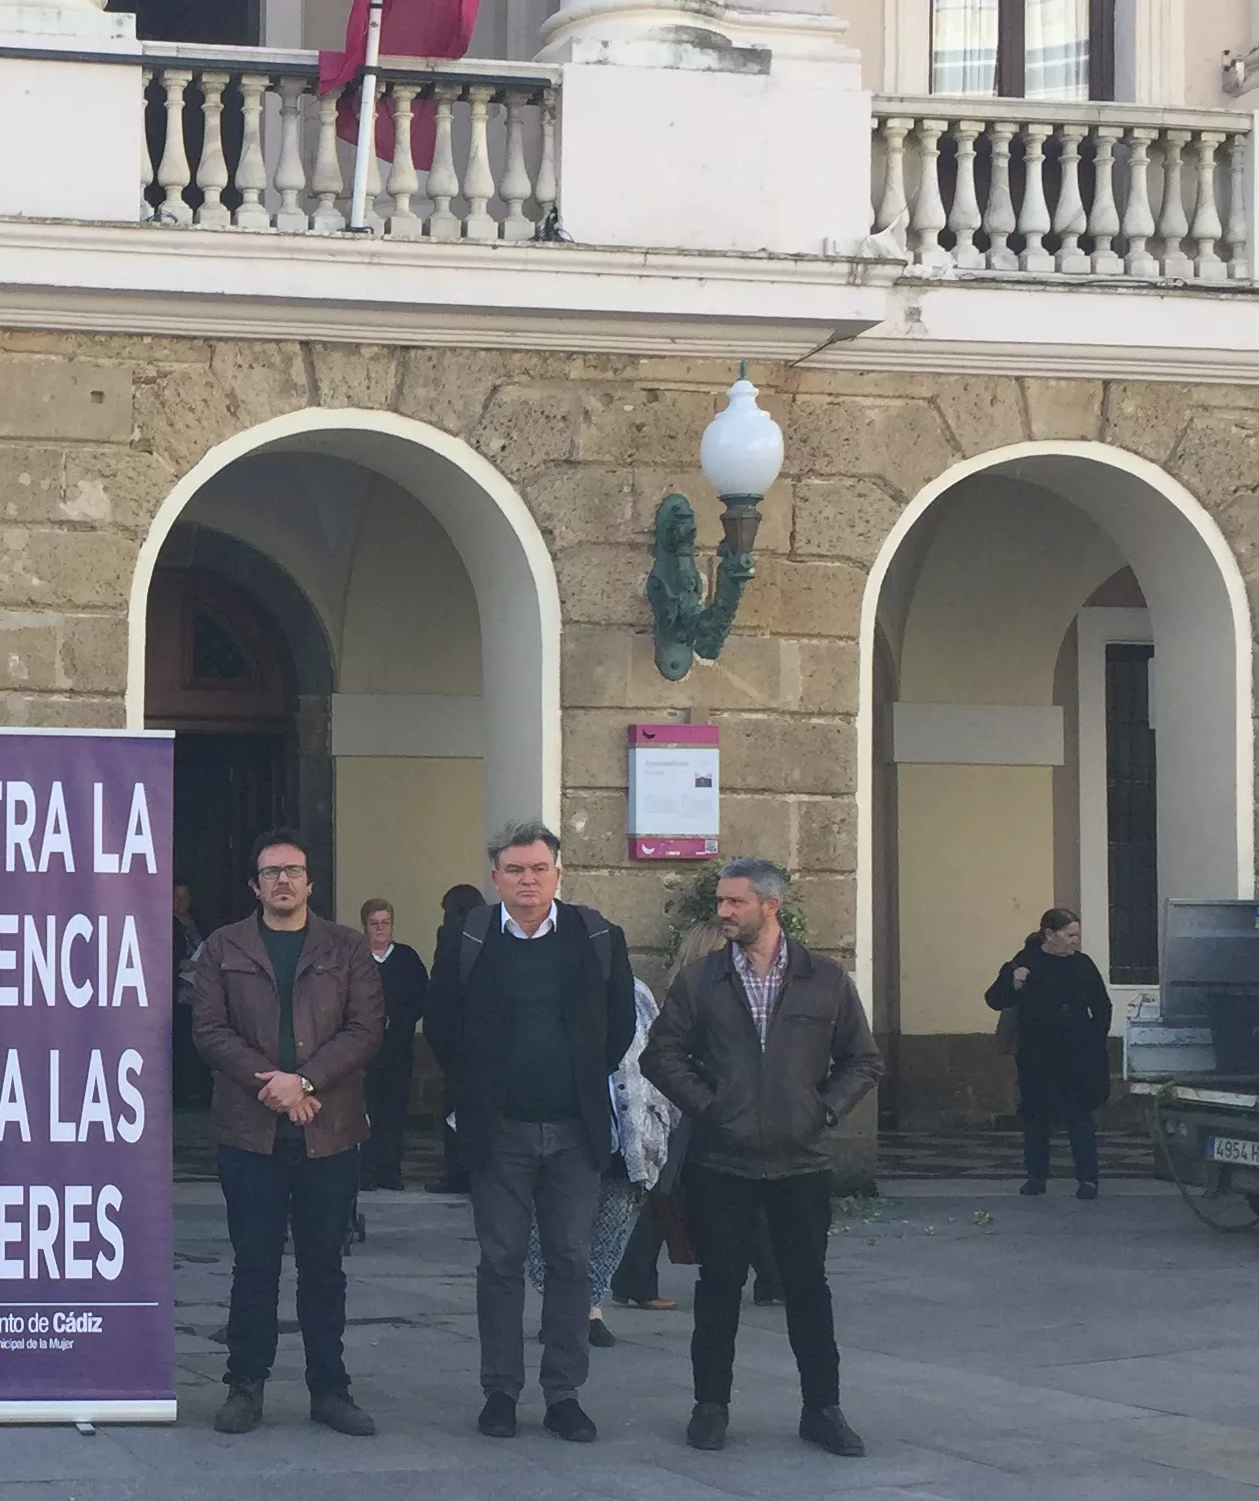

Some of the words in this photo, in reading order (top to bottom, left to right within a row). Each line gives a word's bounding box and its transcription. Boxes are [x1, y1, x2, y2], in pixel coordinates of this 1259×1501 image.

[93, 782, 157, 874] LA
[49, 1048, 145, 1144] LAS
[1216, 1139, 1248, 1160] 4954
[27, 1312, 50, 1334] de
[52, 1311, 103, 1334] Cádiz
[26, 1338, 38, 1350] de
[39, 1337, 48, 1349] la
[49, 1337, 75, 1351] Mujer
